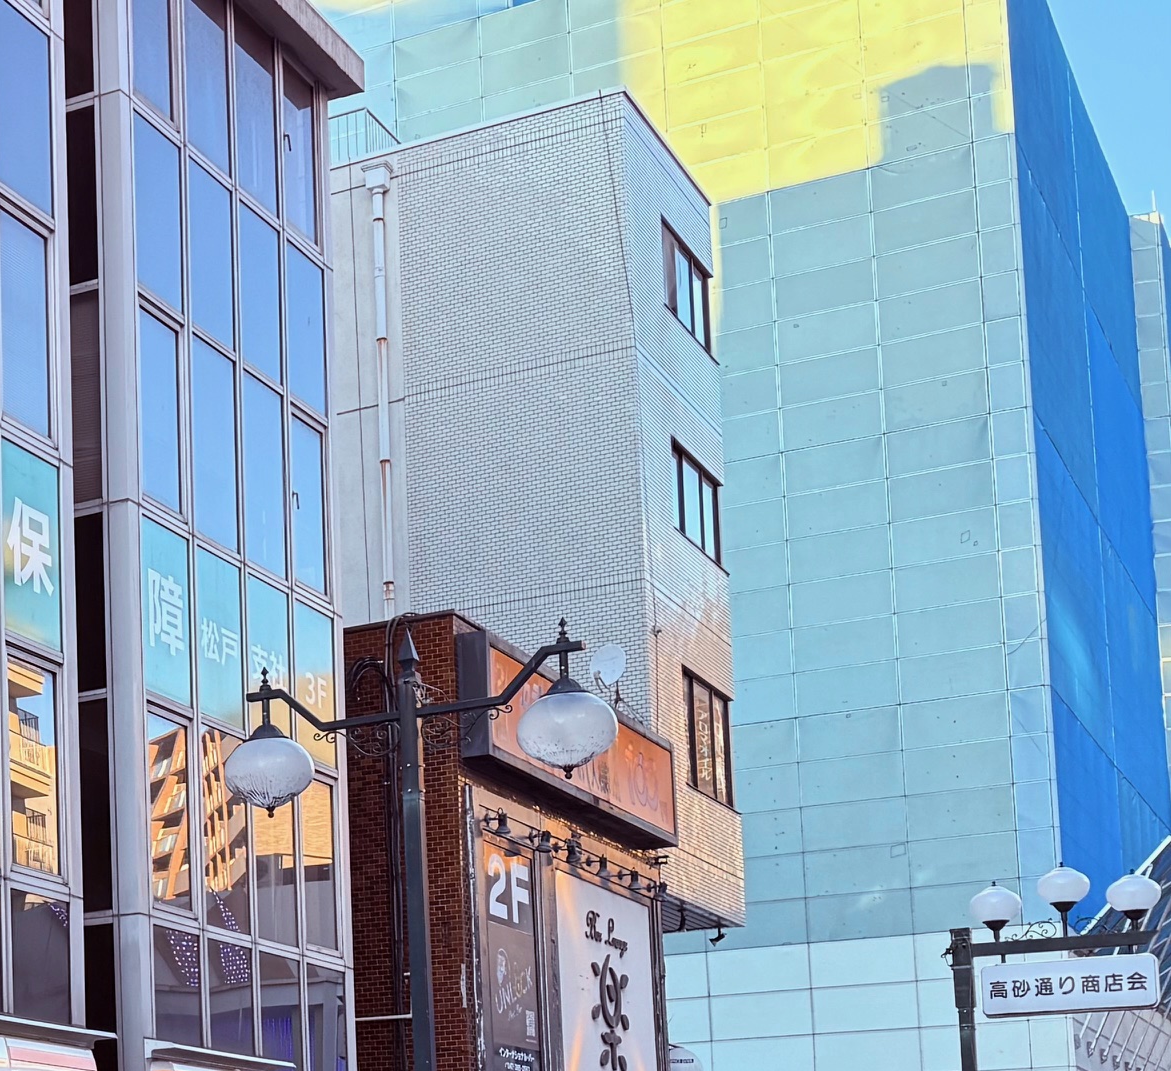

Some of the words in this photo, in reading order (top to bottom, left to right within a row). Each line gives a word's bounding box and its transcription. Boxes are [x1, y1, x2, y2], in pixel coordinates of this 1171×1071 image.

[200, 617, 288, 691] 松戸支社
[305, 672, 327, 709] 3F
[487, 853, 530, 924] 2F
[989, 971, 1148, 1000] 高砂通り商店会
